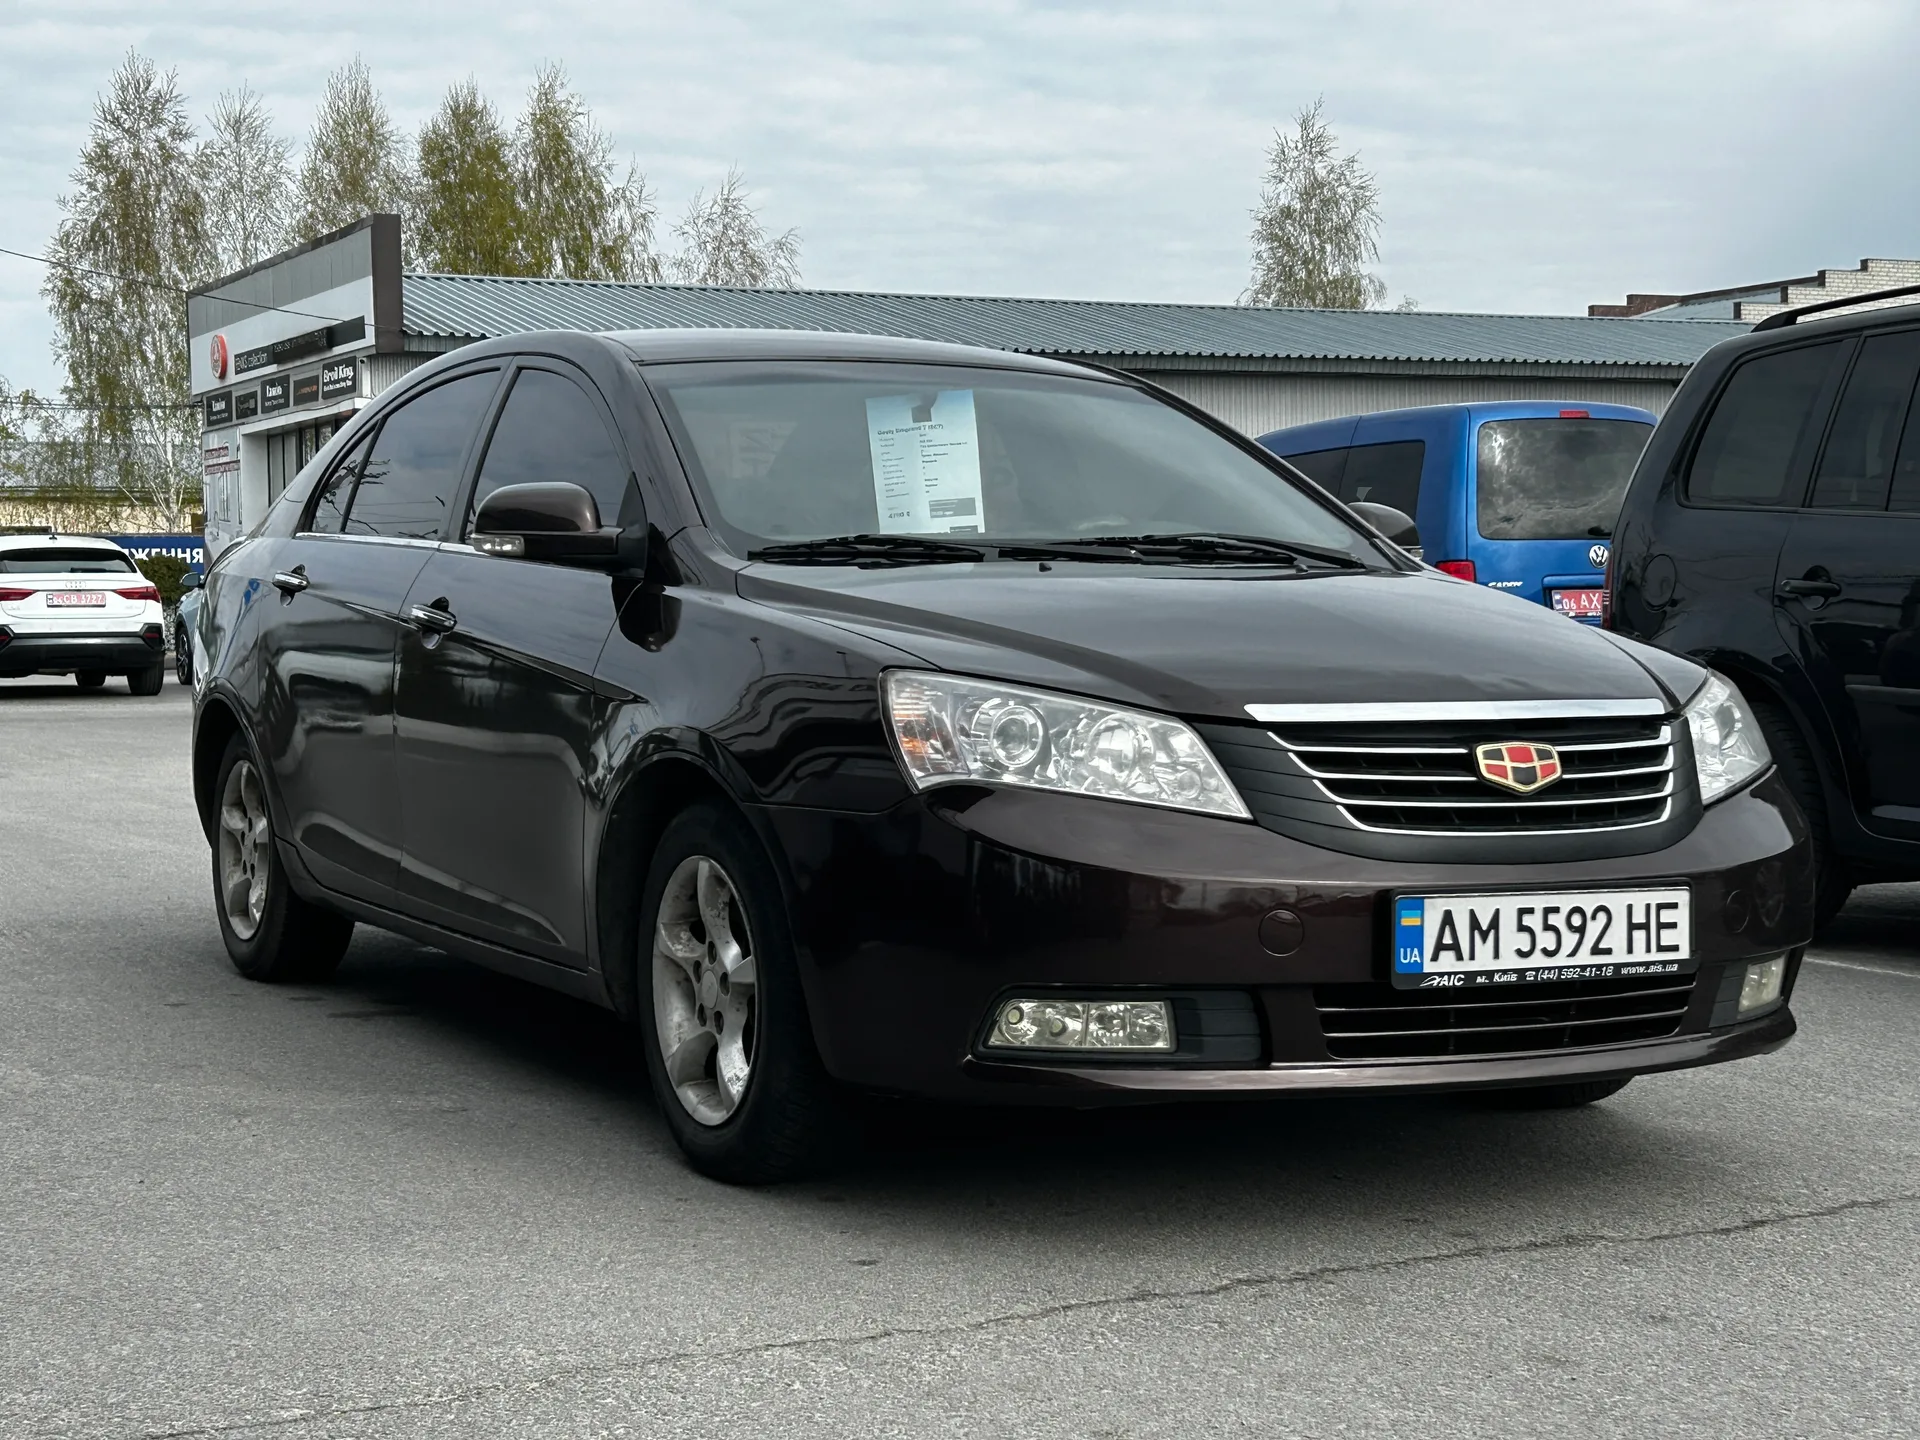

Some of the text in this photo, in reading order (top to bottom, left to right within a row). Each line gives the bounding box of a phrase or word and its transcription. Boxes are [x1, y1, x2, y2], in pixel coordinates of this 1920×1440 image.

[1562, 592, 1601, 610] 06 AX
[1430, 901, 1680, 962] AM 5592 HE
[1400, 948, 1421, 963] UA
[1537, 968, 1559, 982] (44)
[1620, 963, 1679, 975] www.ais.ua
